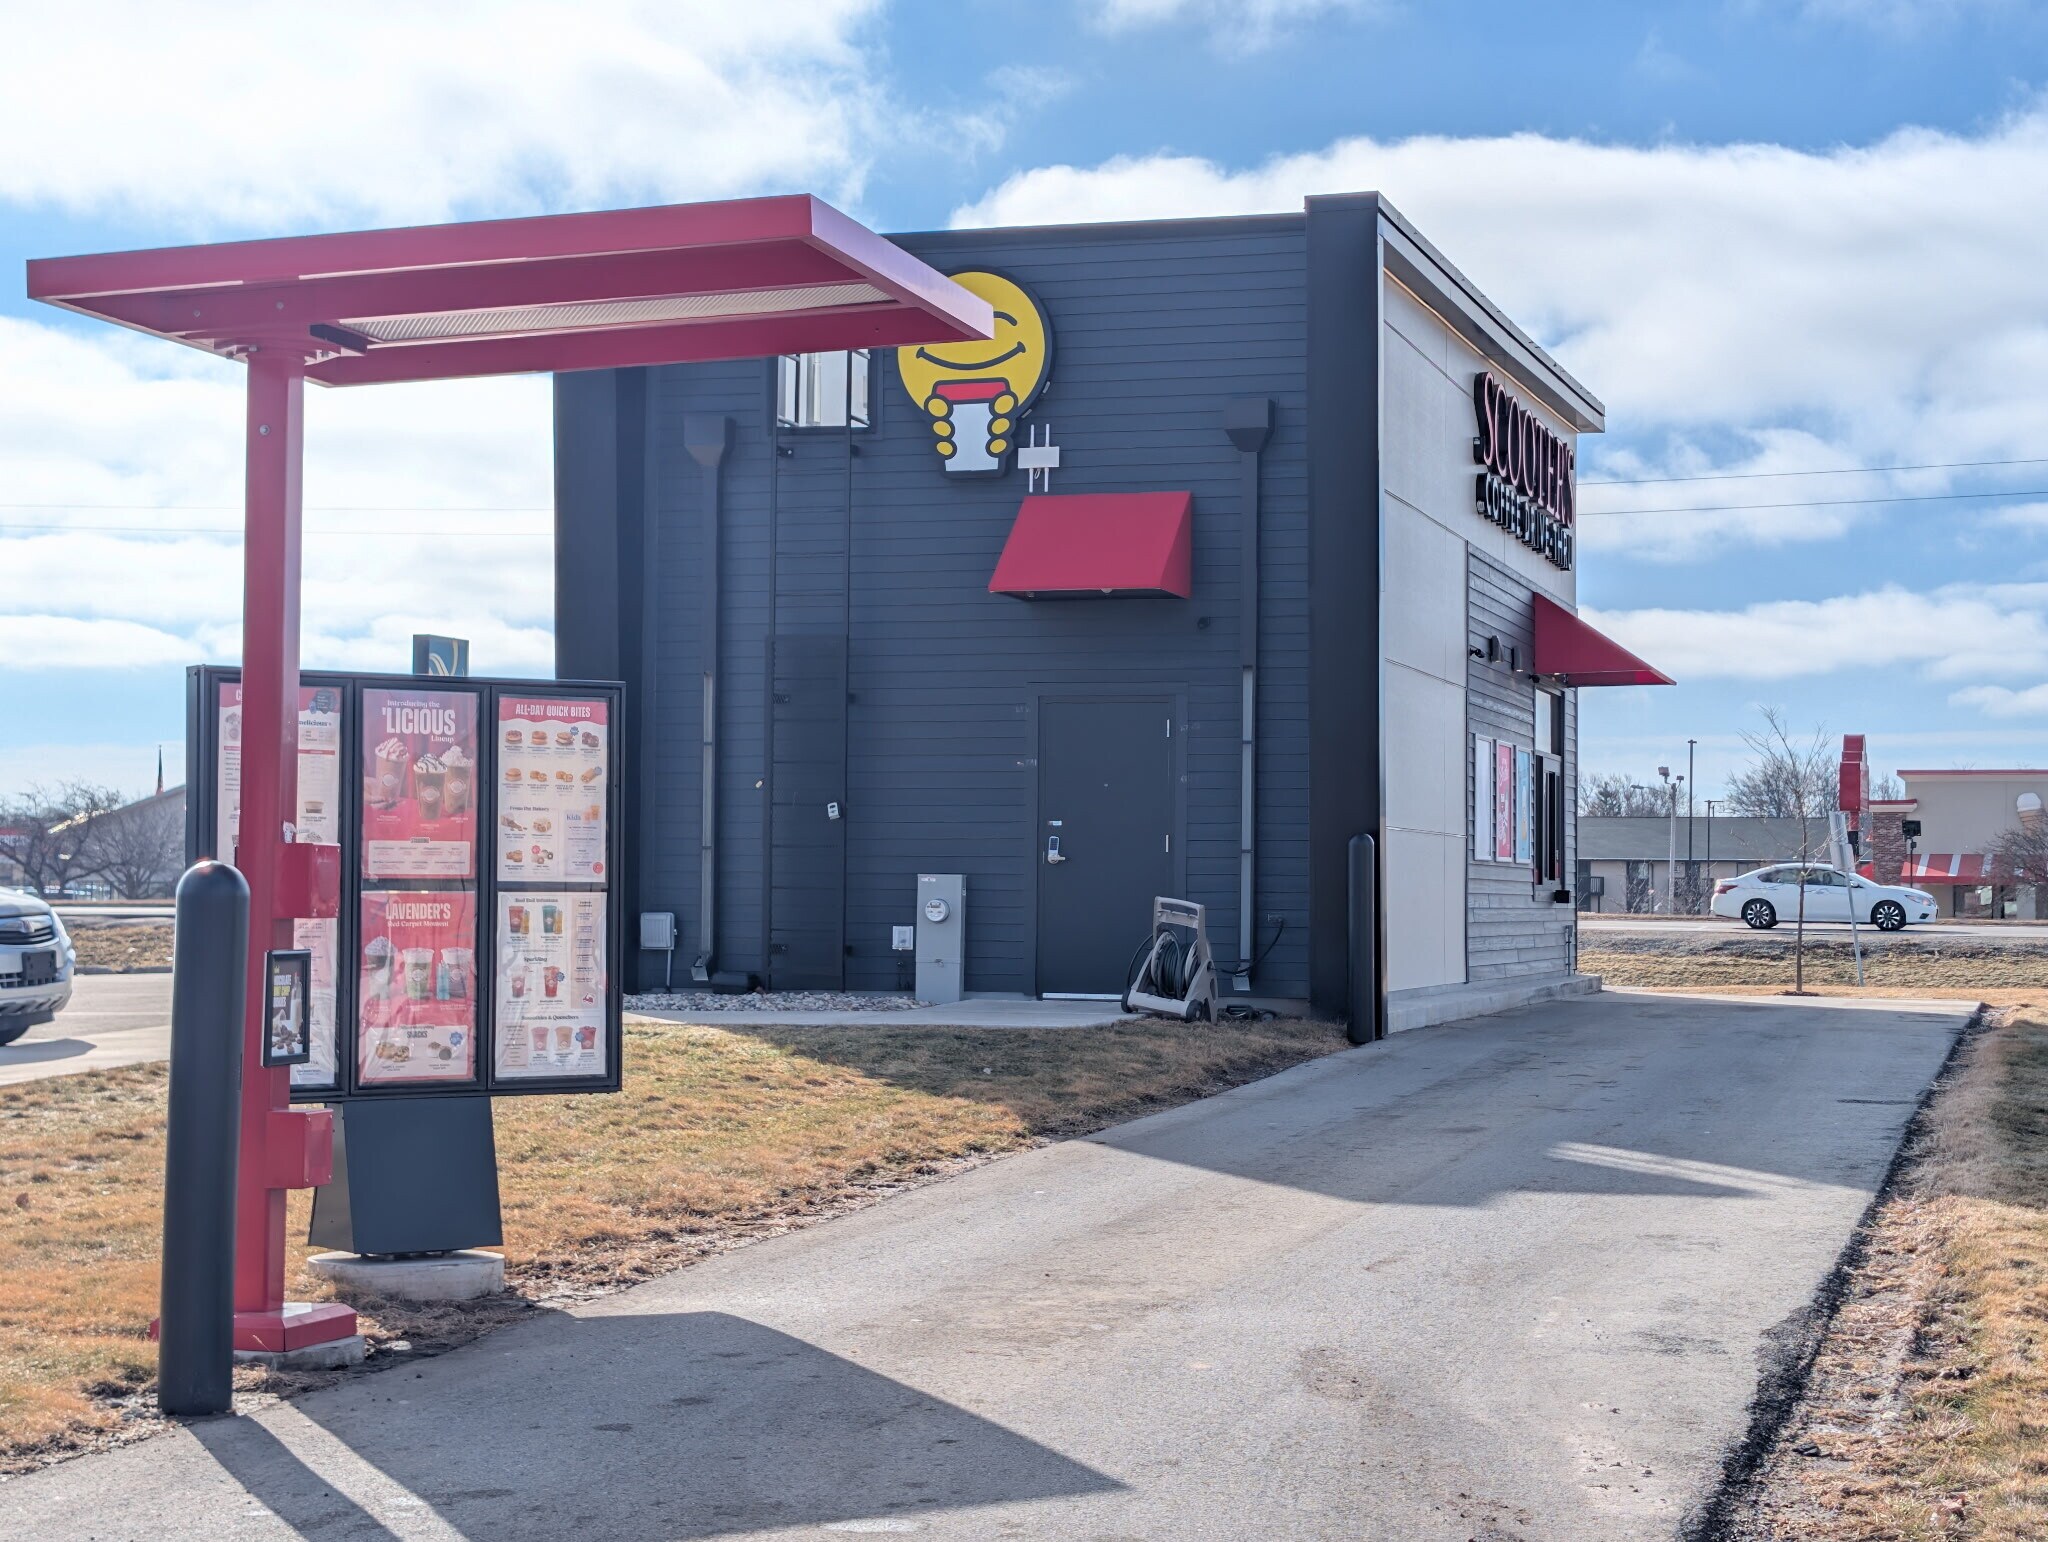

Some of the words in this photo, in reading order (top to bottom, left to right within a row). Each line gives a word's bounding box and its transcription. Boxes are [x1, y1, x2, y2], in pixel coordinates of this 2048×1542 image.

[1479, 472, 1523, 538] COFFEE
[387, 699, 428, 709] Introducing
[428, 700, 440, 708] the
[546, 705, 569, 717] QUICK
[570, 706, 591, 718] BITES
[382, 707, 456, 736] 'LICIOUS
[385, 902, 451, 920] LAVENDER'S
[401, 920, 422, 928] Carpet
